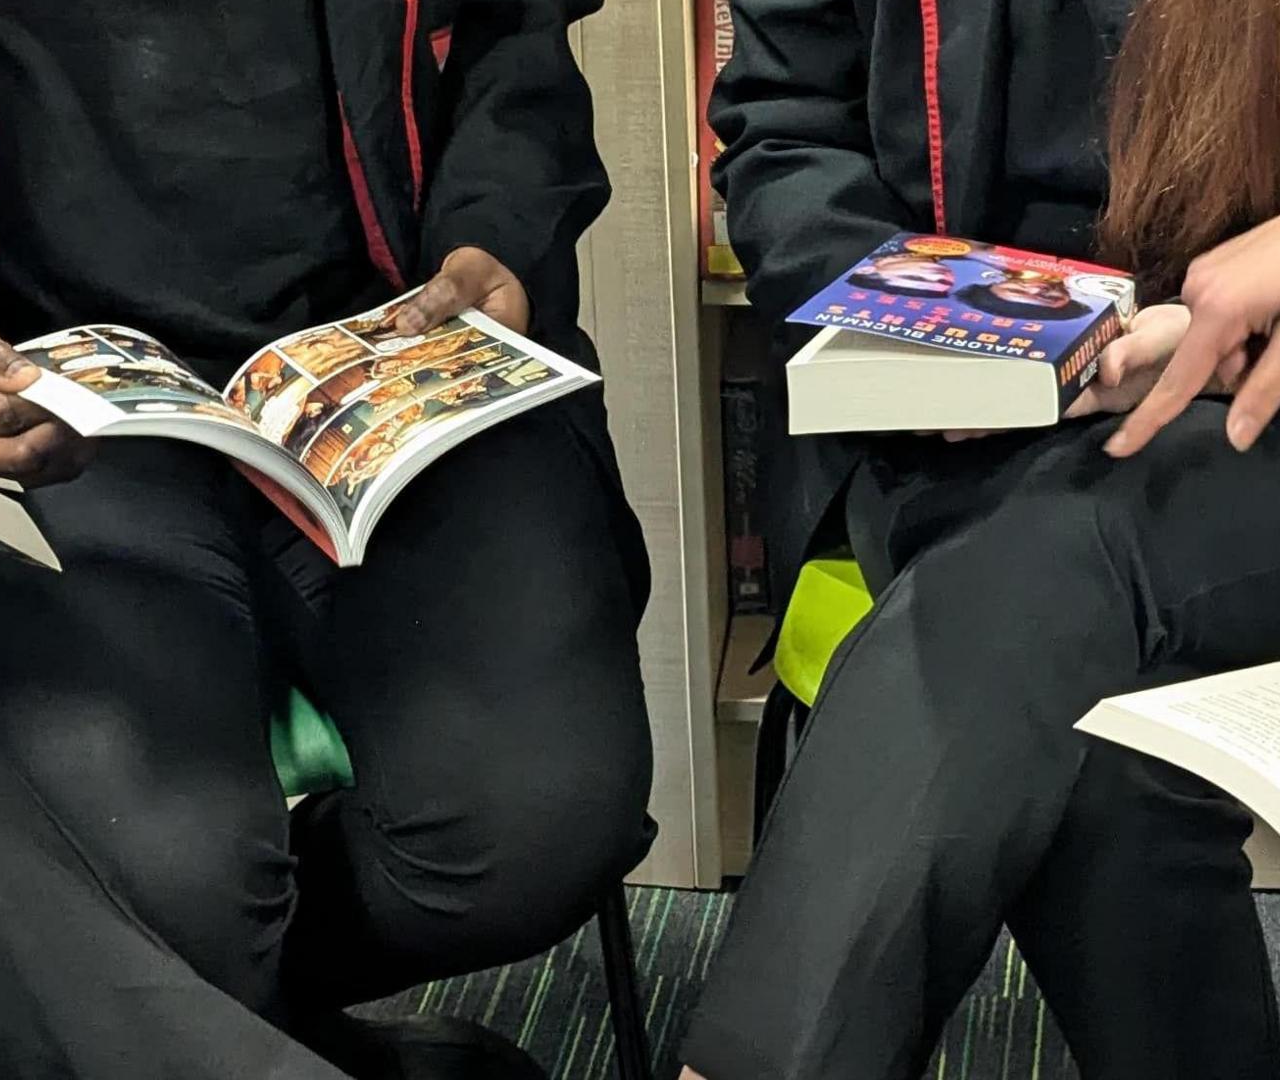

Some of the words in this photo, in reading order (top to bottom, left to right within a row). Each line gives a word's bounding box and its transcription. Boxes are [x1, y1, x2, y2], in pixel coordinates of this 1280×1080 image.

[813, 312, 927, 340] BLACKMAN
[825, 303, 1035, 349] NOUGHTS
[933, 333, 1025, 357] MALORIE
